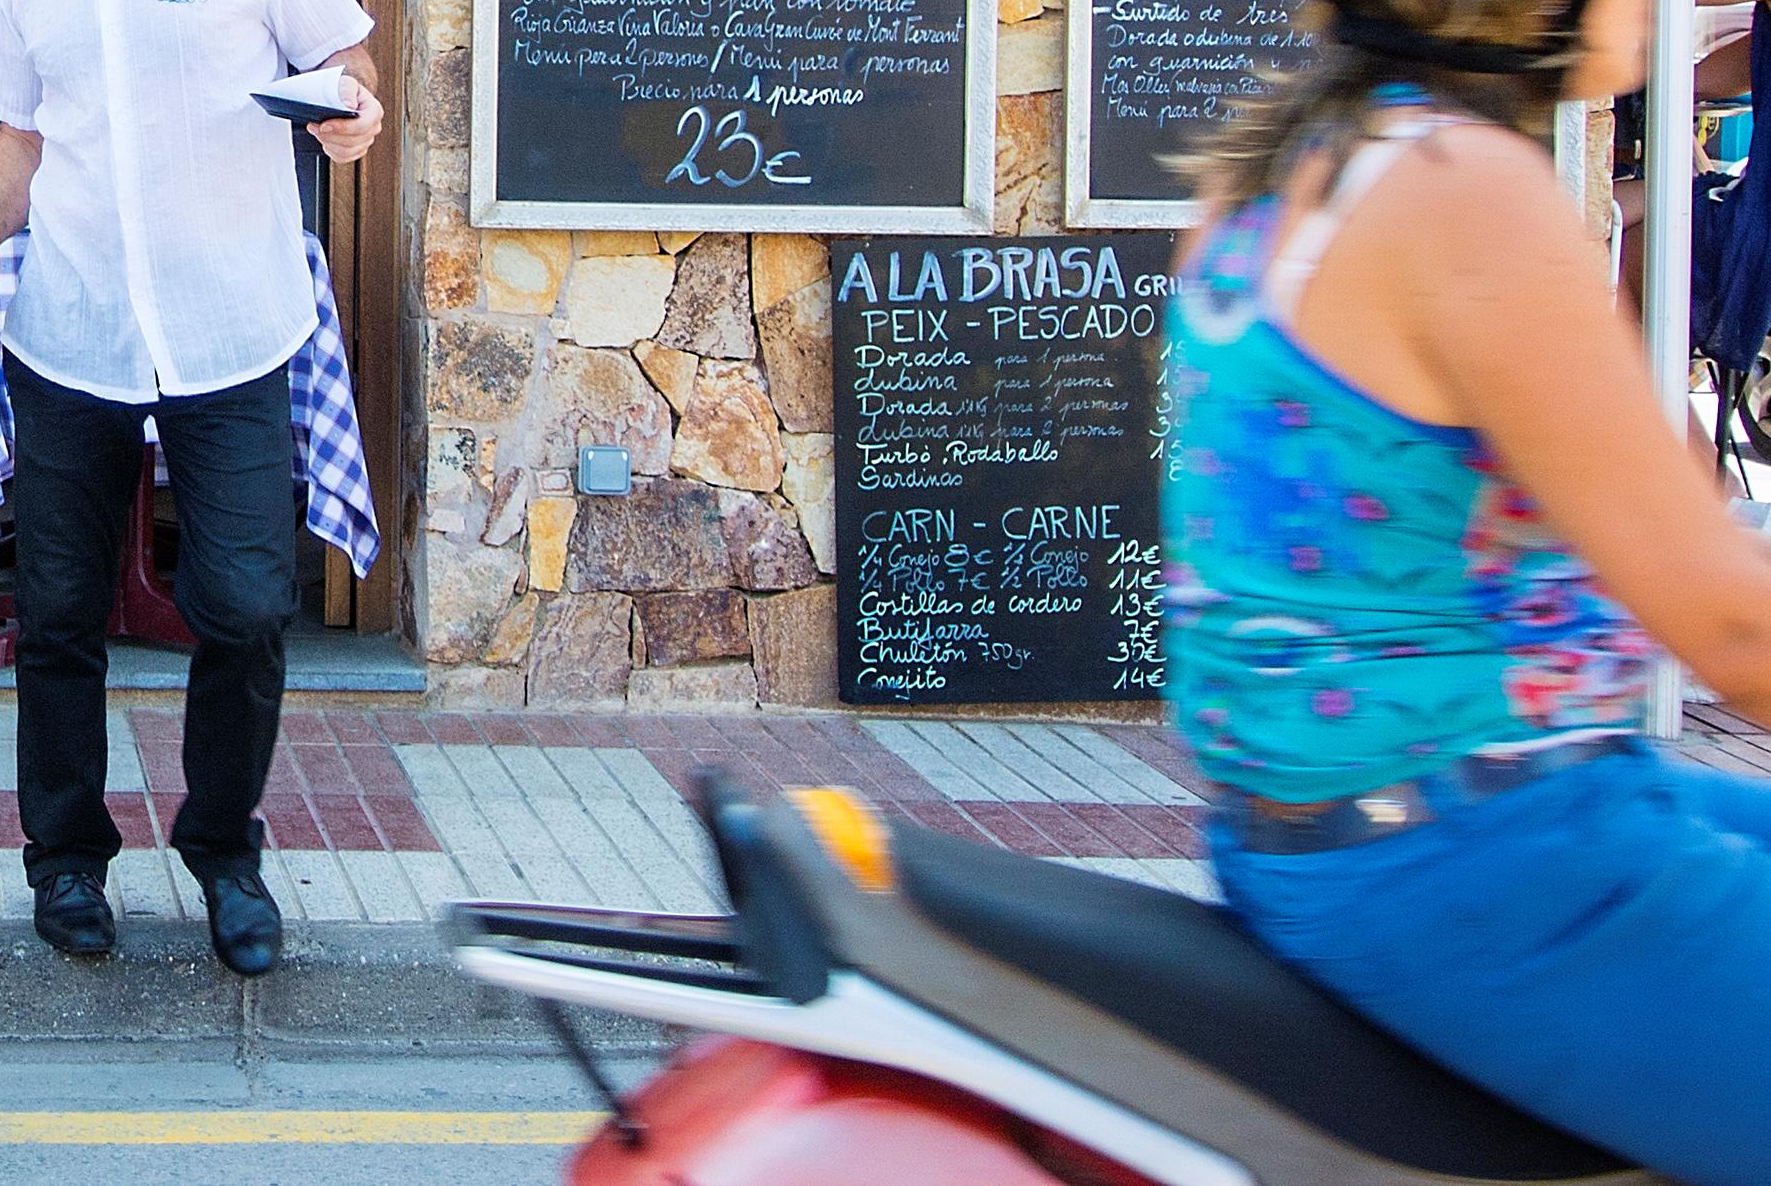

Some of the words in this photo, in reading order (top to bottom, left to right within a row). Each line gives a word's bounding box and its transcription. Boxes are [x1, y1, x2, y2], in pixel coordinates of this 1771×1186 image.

[1200, 6, 1222, 22] de
[1106, 24, 1178, 47] Dorada
[1108, 56, 1139, 70] con
[744, 75, 761, 101] 1
[765, 80, 865, 117] personas
[837, 251, 878, 303] A
[888, 251, 949, 302] LA
[951, 246, 1126, 303] BRASA
[861, 309, 949, 343] PEIX
[987, 304, 1155, 340] PESCADO
[854, 345, 971, 369] Dorada
[856, 392, 952, 418] Dorada
[946, 440, 1058, 464] Rodaballo
[857, 466, 963, 490] Sardinas
[862, 509, 955, 543] CARN
[1001, 504, 1121, 540] CARNE
[889, 545, 941, 575] Conejo
[1029, 541, 1089, 571] Conejo
[1107, 540, 1162, 565] 12€
[888, 567, 945, 593] Pollo
[1026, 564, 1088, 589] Pollo
[1109, 569, 1166, 590] 11€
[859, 591, 963, 616] Costillas
[971, 595, 996, 615] de
[1008, 593, 1082, 613] cordero
[1110, 593, 1165, 617] 13€
[858, 617, 989, 650] Butifarra
[1124, 619, 1158, 644] 7€
[860, 641, 967, 664] Chuletón
[1107, 640, 1167, 663] 30€
[857, 666, 946, 700] Conejito
[1113, 667, 1166, 691] 14€
